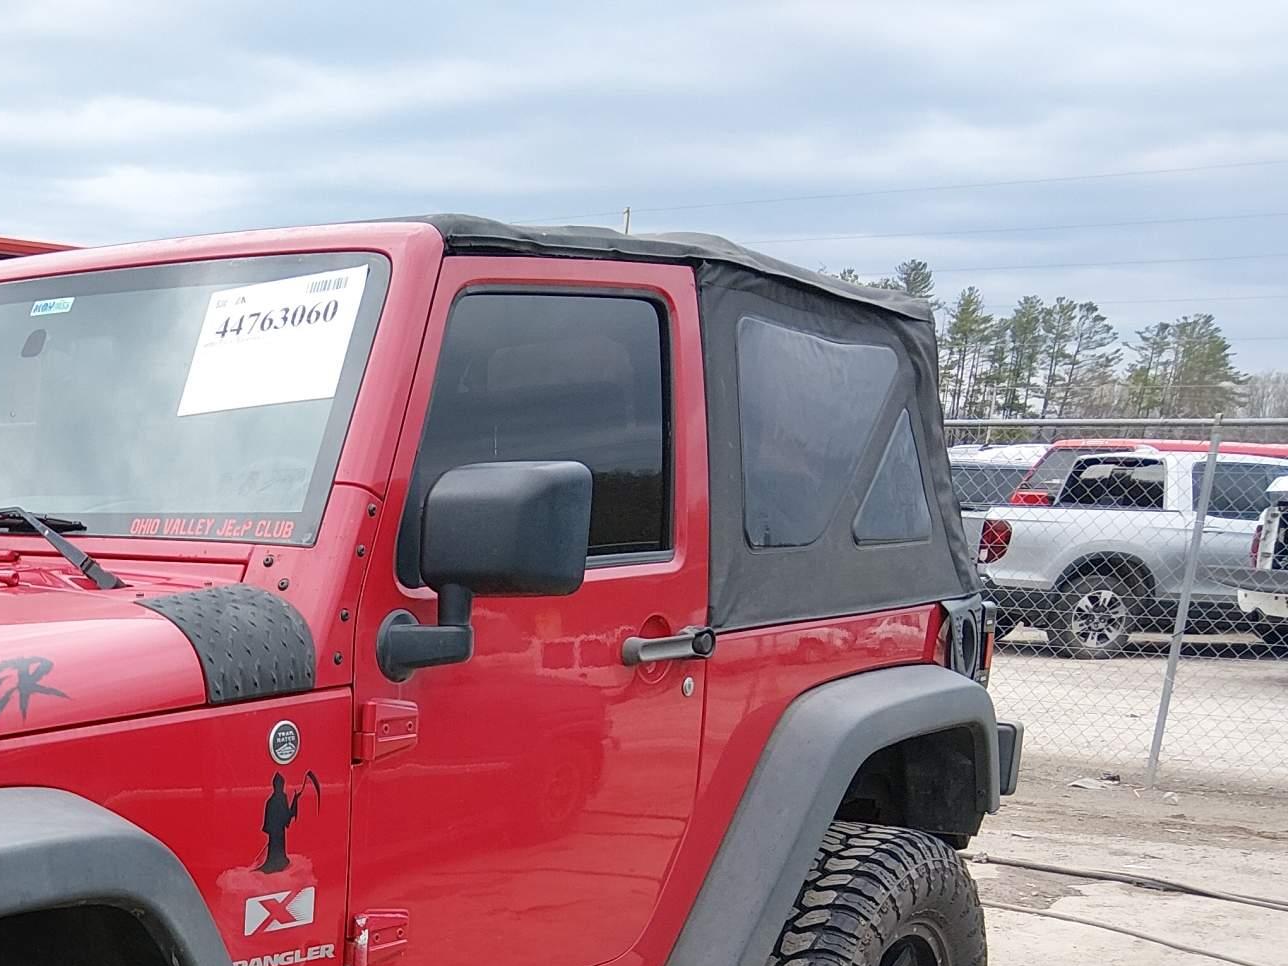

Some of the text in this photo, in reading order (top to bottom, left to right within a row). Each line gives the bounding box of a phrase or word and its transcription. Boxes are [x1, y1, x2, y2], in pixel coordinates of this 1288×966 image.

[215, 299, 339, 338] 44763060
[130, 518, 160, 535] OHIO
[163, 518, 215, 536] VALLEY
[255, 520, 295, 538] CLUB
